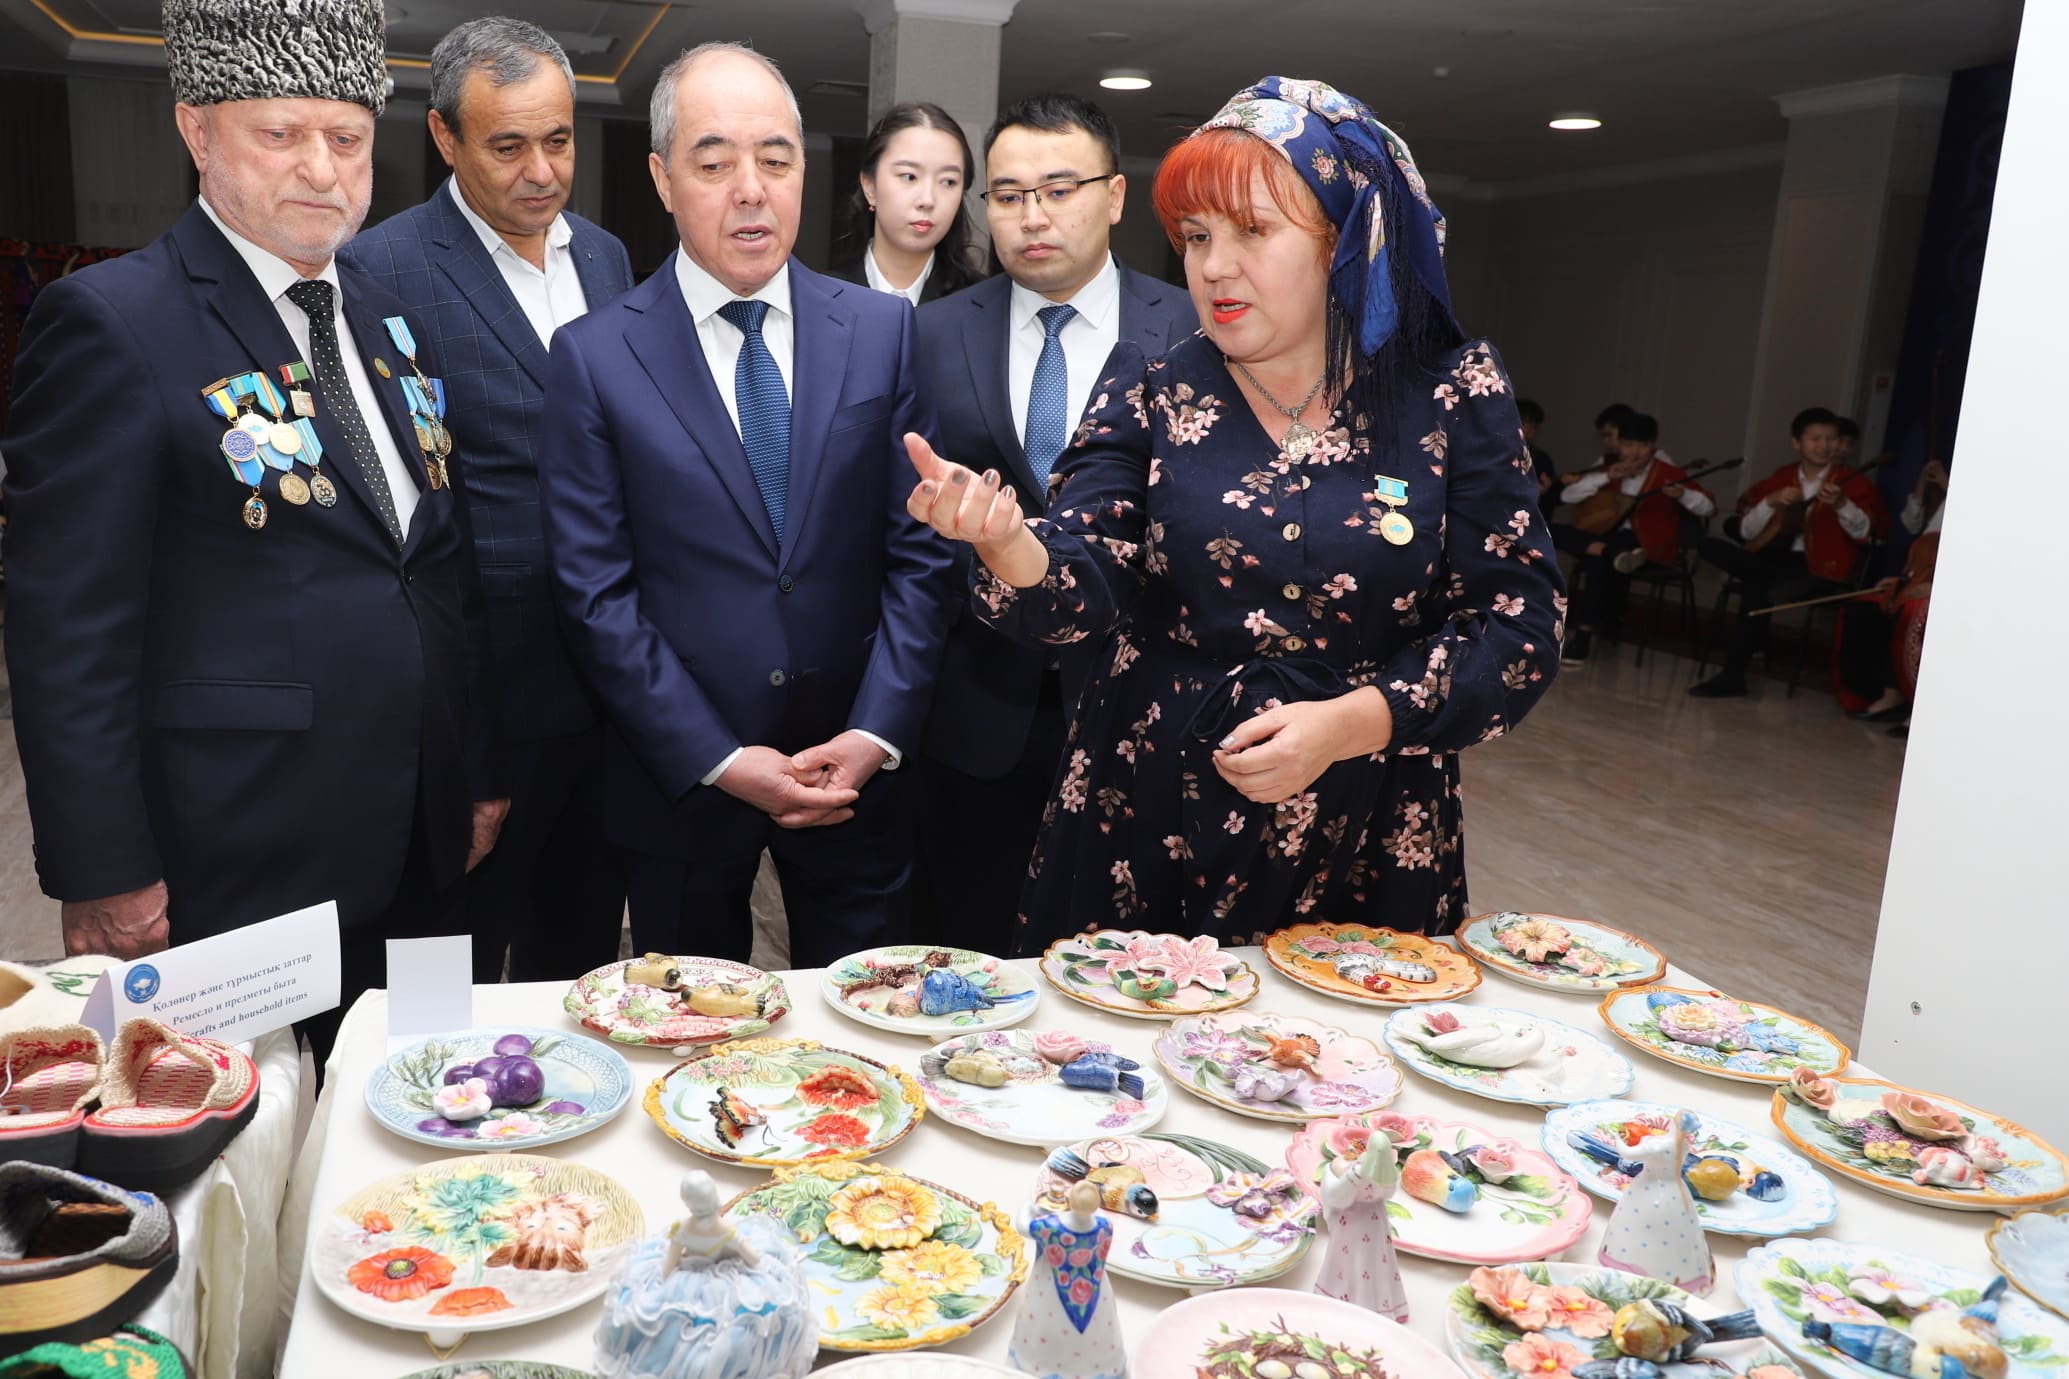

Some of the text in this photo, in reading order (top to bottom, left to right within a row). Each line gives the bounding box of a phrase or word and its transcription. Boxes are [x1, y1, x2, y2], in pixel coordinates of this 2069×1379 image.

[199, 983, 224, 996] және
[283, 953, 312, 969] заттар
[173, 1006, 213, 1026] Ремесло
[225, 986, 272, 1008] предметы
[273, 977, 297, 991] быта
[183, 992, 308, 1039] crafts and household items
